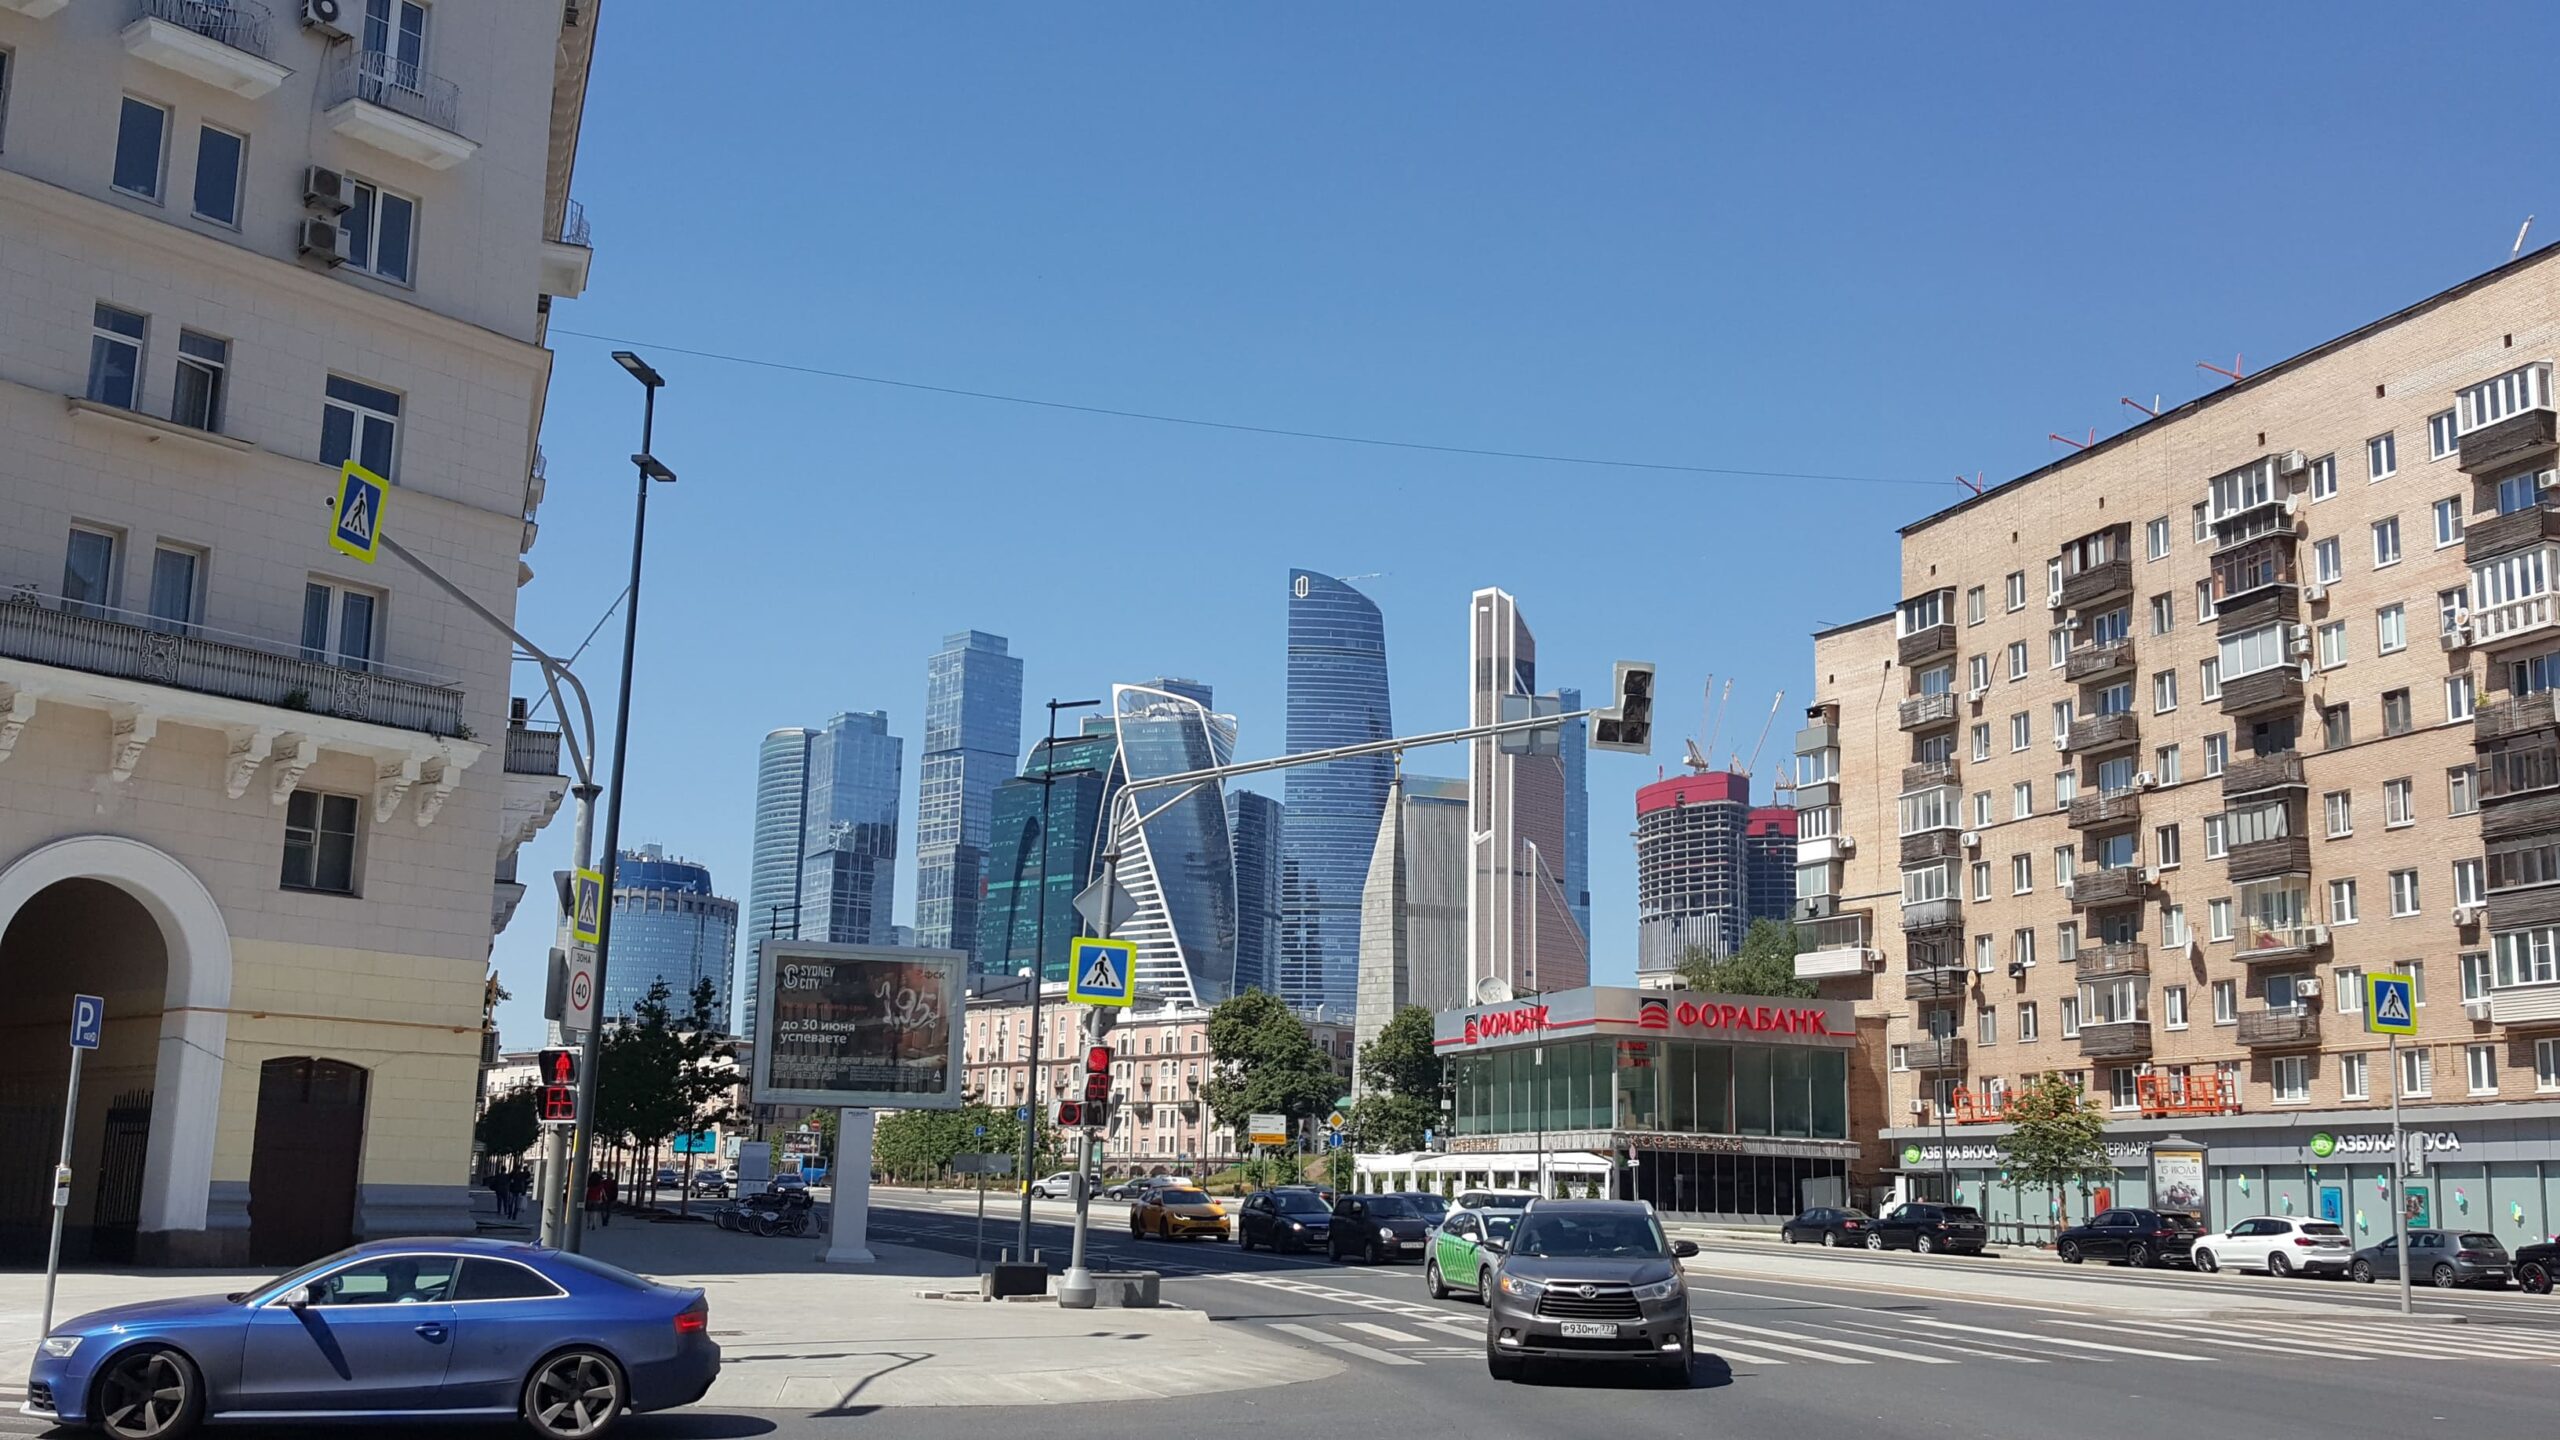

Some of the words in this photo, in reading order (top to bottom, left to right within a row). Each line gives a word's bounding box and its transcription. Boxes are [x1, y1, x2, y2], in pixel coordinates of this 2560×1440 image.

[576, 952, 592, 964] ЗОНА
[800, 965, 836, 977] SYDNEY
[924, 970, 946, 980] ФСК
[575, 983, 588, 999] 40
[799, 978, 820, 990] CITY
[75, 1001, 94, 1041] P
[781, 1020, 799, 1032] до
[801, 1019, 818, 1031] 30
[821, 1021, 855, 1032] июня
[1479, 1005, 1550, 1038] ФОРАБАНК
[1675, 1001, 1828, 1036] ФОРАБАНК
[780, 1033, 847, 1044] успеваете
[2403, 1132, 2460, 1150] УСА
[1962, 1144, 1998, 1159] ВКУСА
